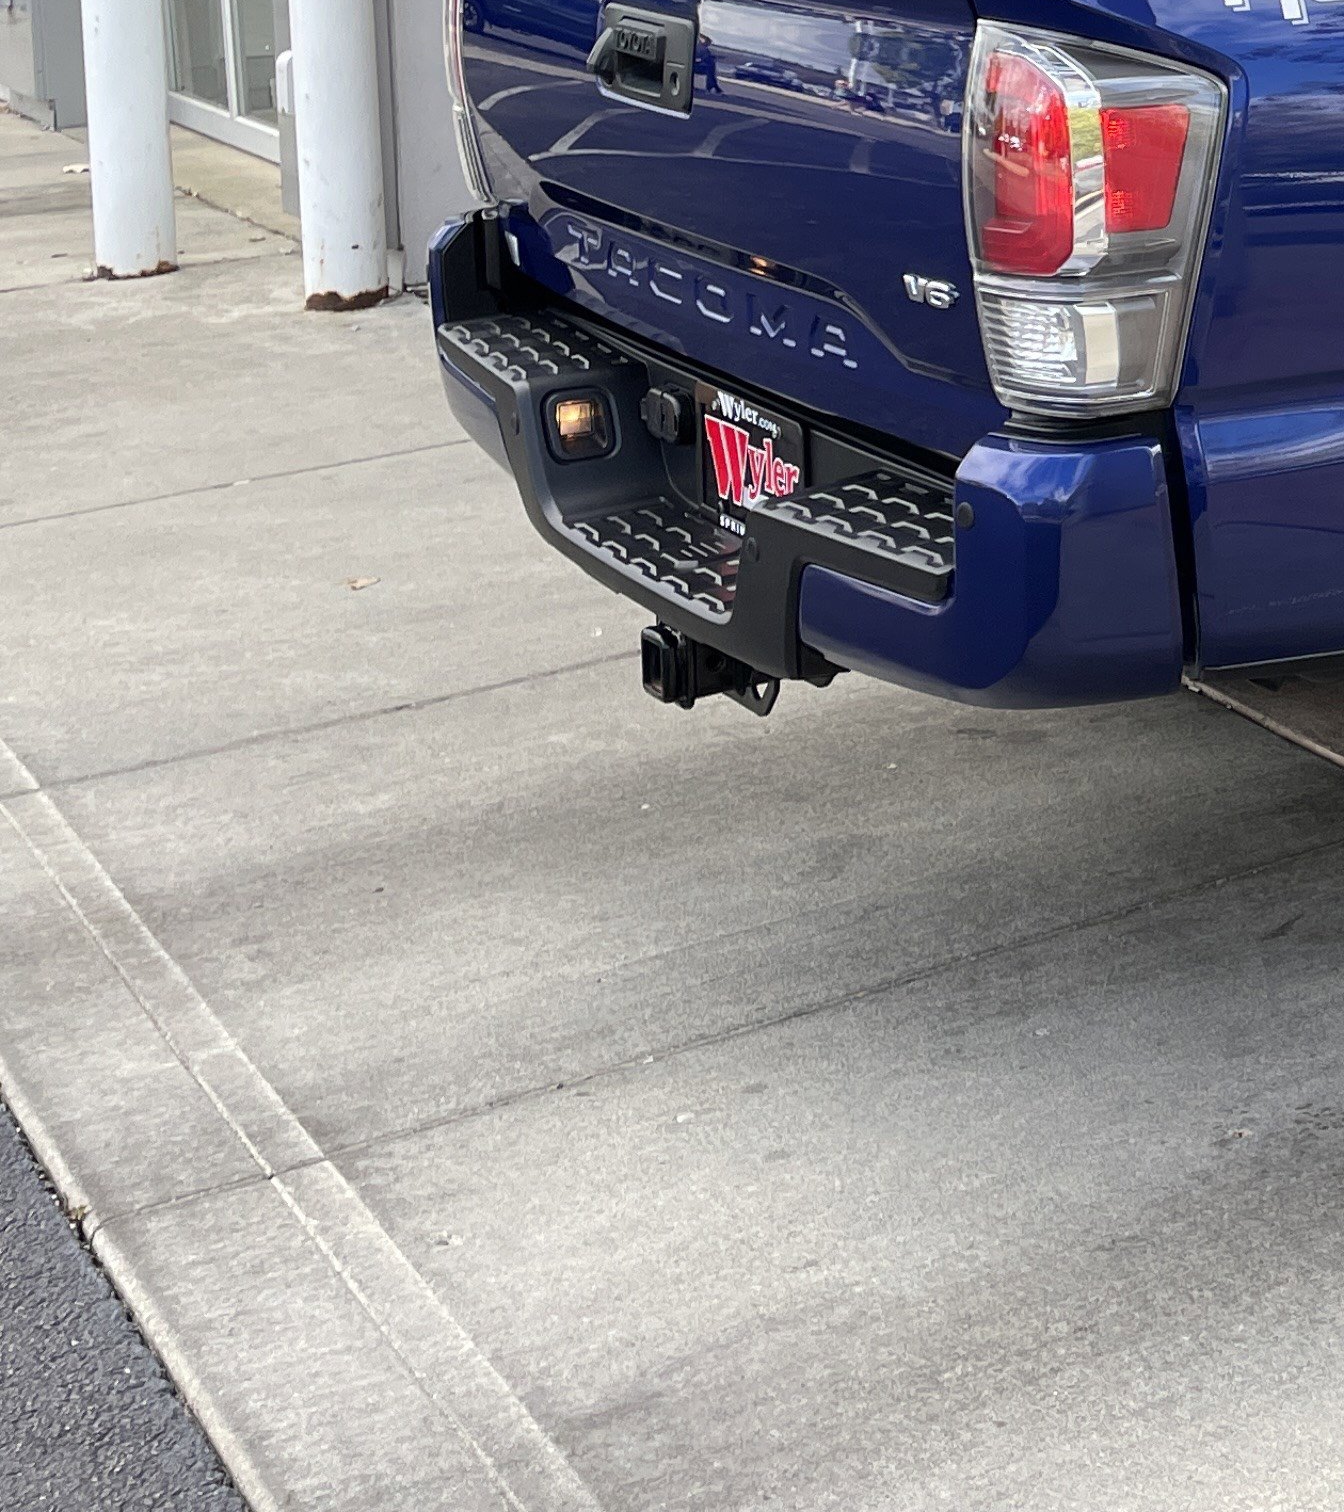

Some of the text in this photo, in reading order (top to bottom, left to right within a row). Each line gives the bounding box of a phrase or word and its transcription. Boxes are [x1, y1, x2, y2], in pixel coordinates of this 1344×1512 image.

[567, 224, 859, 369] TACOMA
[902, 274, 960, 309] V6
[704, 414, 800, 506] Wyler
